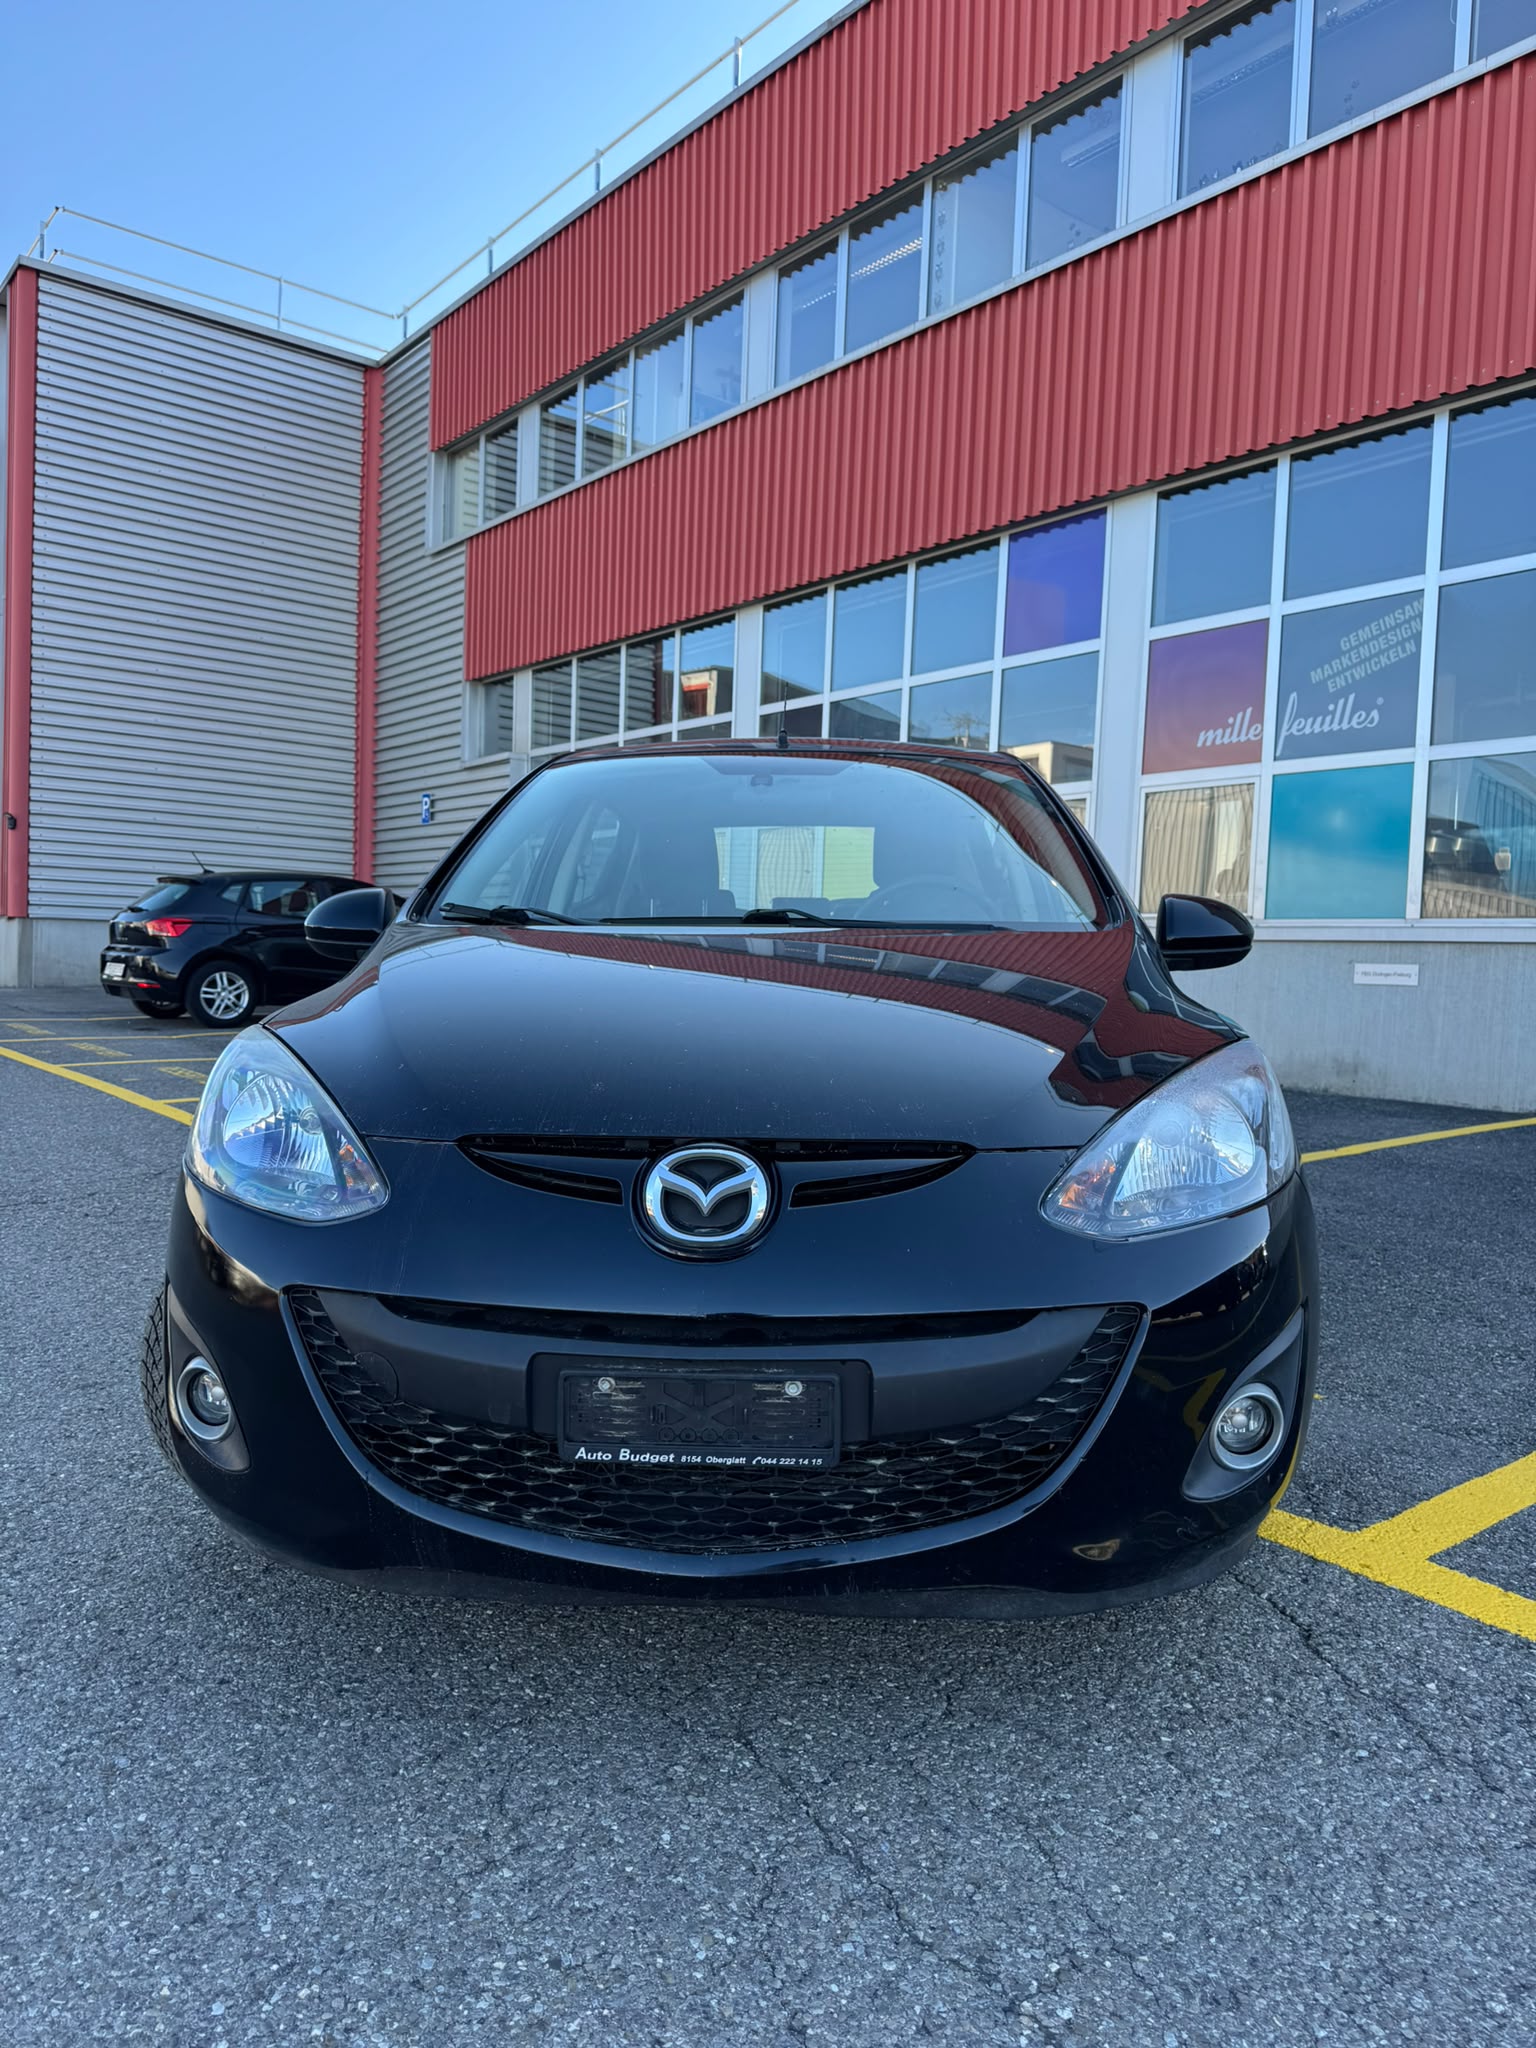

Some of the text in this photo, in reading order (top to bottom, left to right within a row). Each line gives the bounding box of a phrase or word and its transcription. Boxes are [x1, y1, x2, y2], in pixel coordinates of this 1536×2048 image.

[1310, 618, 1422, 684] MARKENDESIGN
[1327, 639, 1417, 693] ENTWICKELN
[1196, 706, 1263, 748] mille
[422, 796, 430, 819] P
[575, 1446, 612, 1461] Auto
[619, 1448, 675, 1463] Budget
[681, 1455, 701, 1463] 8154
[705, 1456, 746, 1465] Oberglatt
[760, 1457, 777, 1465] 044
[799, 1458, 809, 1466] 14
[811, 1458, 823, 1466] 15
